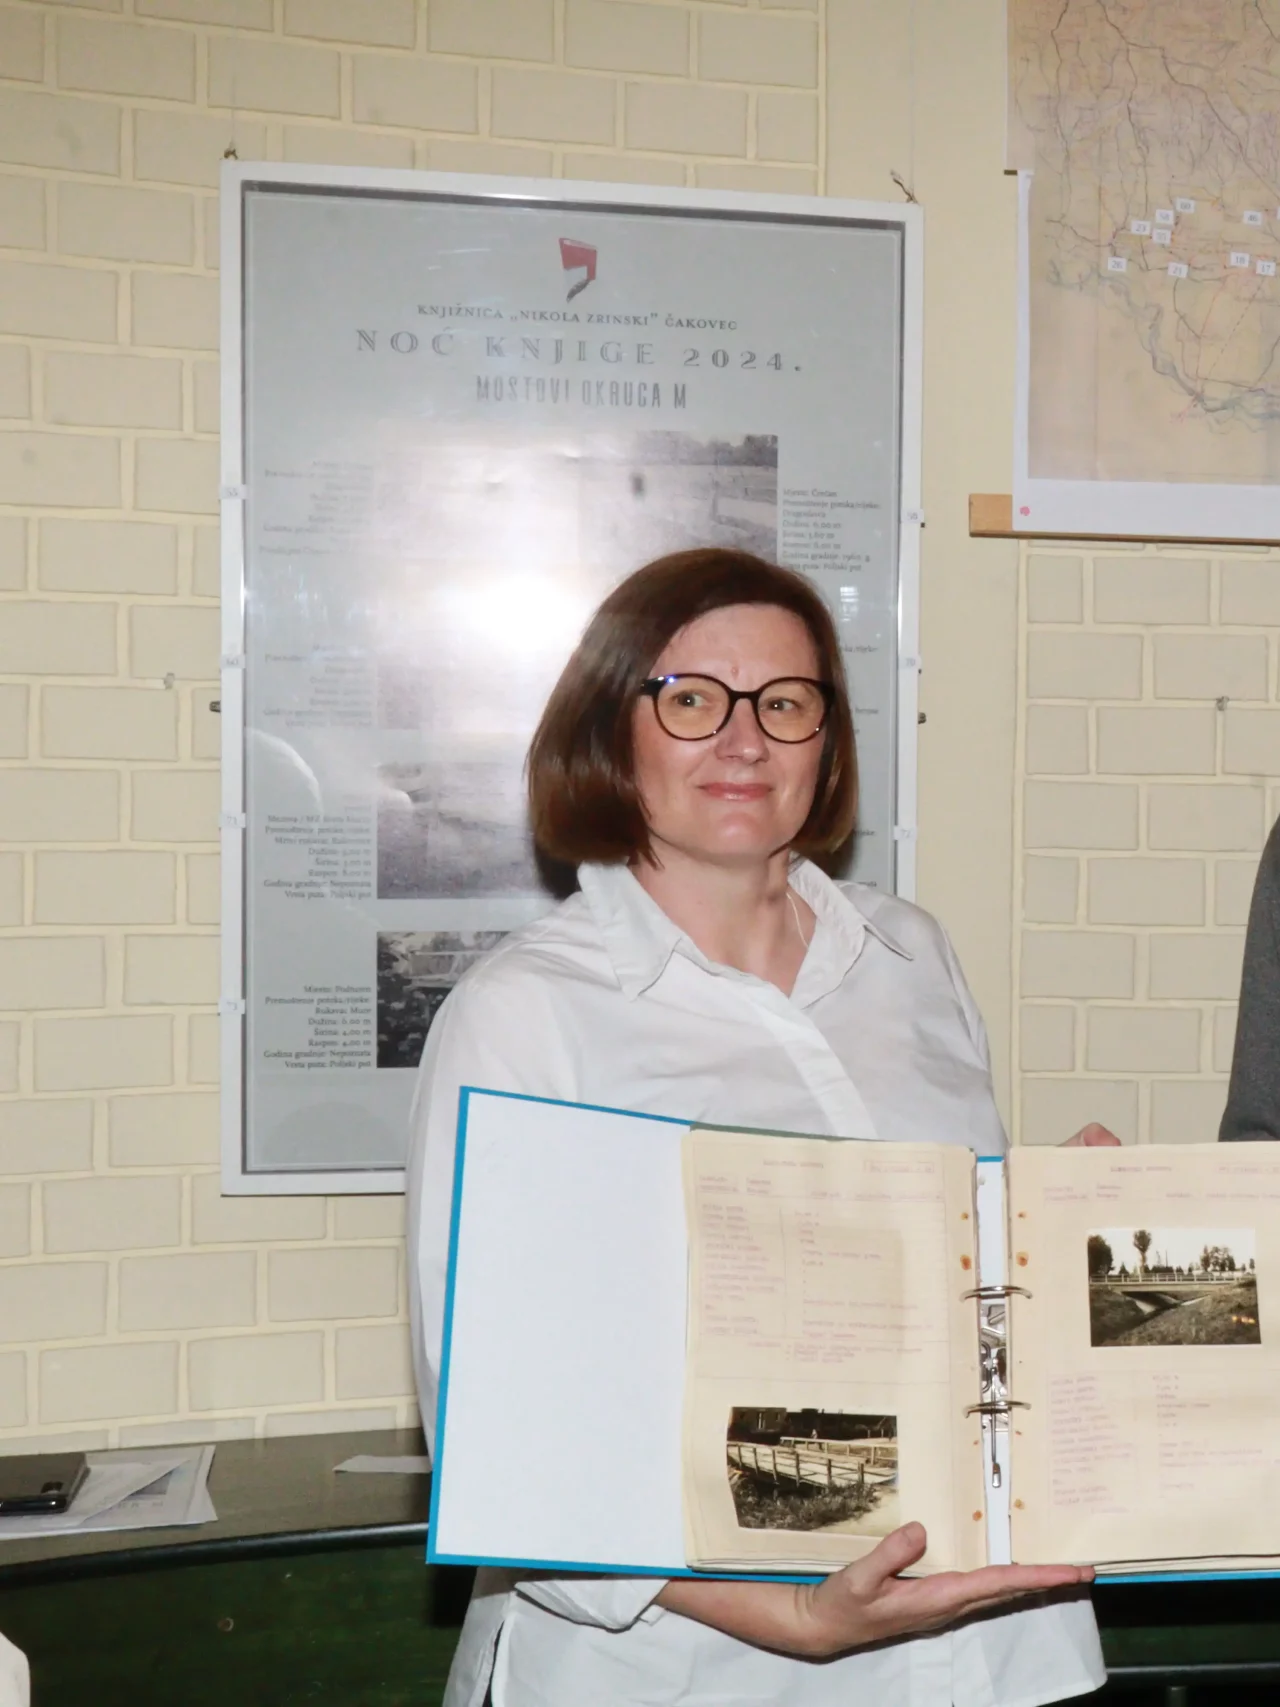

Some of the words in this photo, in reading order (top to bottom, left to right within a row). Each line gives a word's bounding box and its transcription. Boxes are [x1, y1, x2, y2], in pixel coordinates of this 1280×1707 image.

[418, 302, 503, 319] KNJIŽNICA
[665, 312, 738, 330] ČAKOVEC
[356, 325, 455, 356] NOĆ
[485, 336, 655, 366] KNJIGE
[683, 347, 802, 372] 2024.
[476, 375, 570, 404] MOSTOVI
[581, 379, 661, 409] OKRUGA
[674, 383, 688, 410] M
[226, 815, 238, 825] 71
